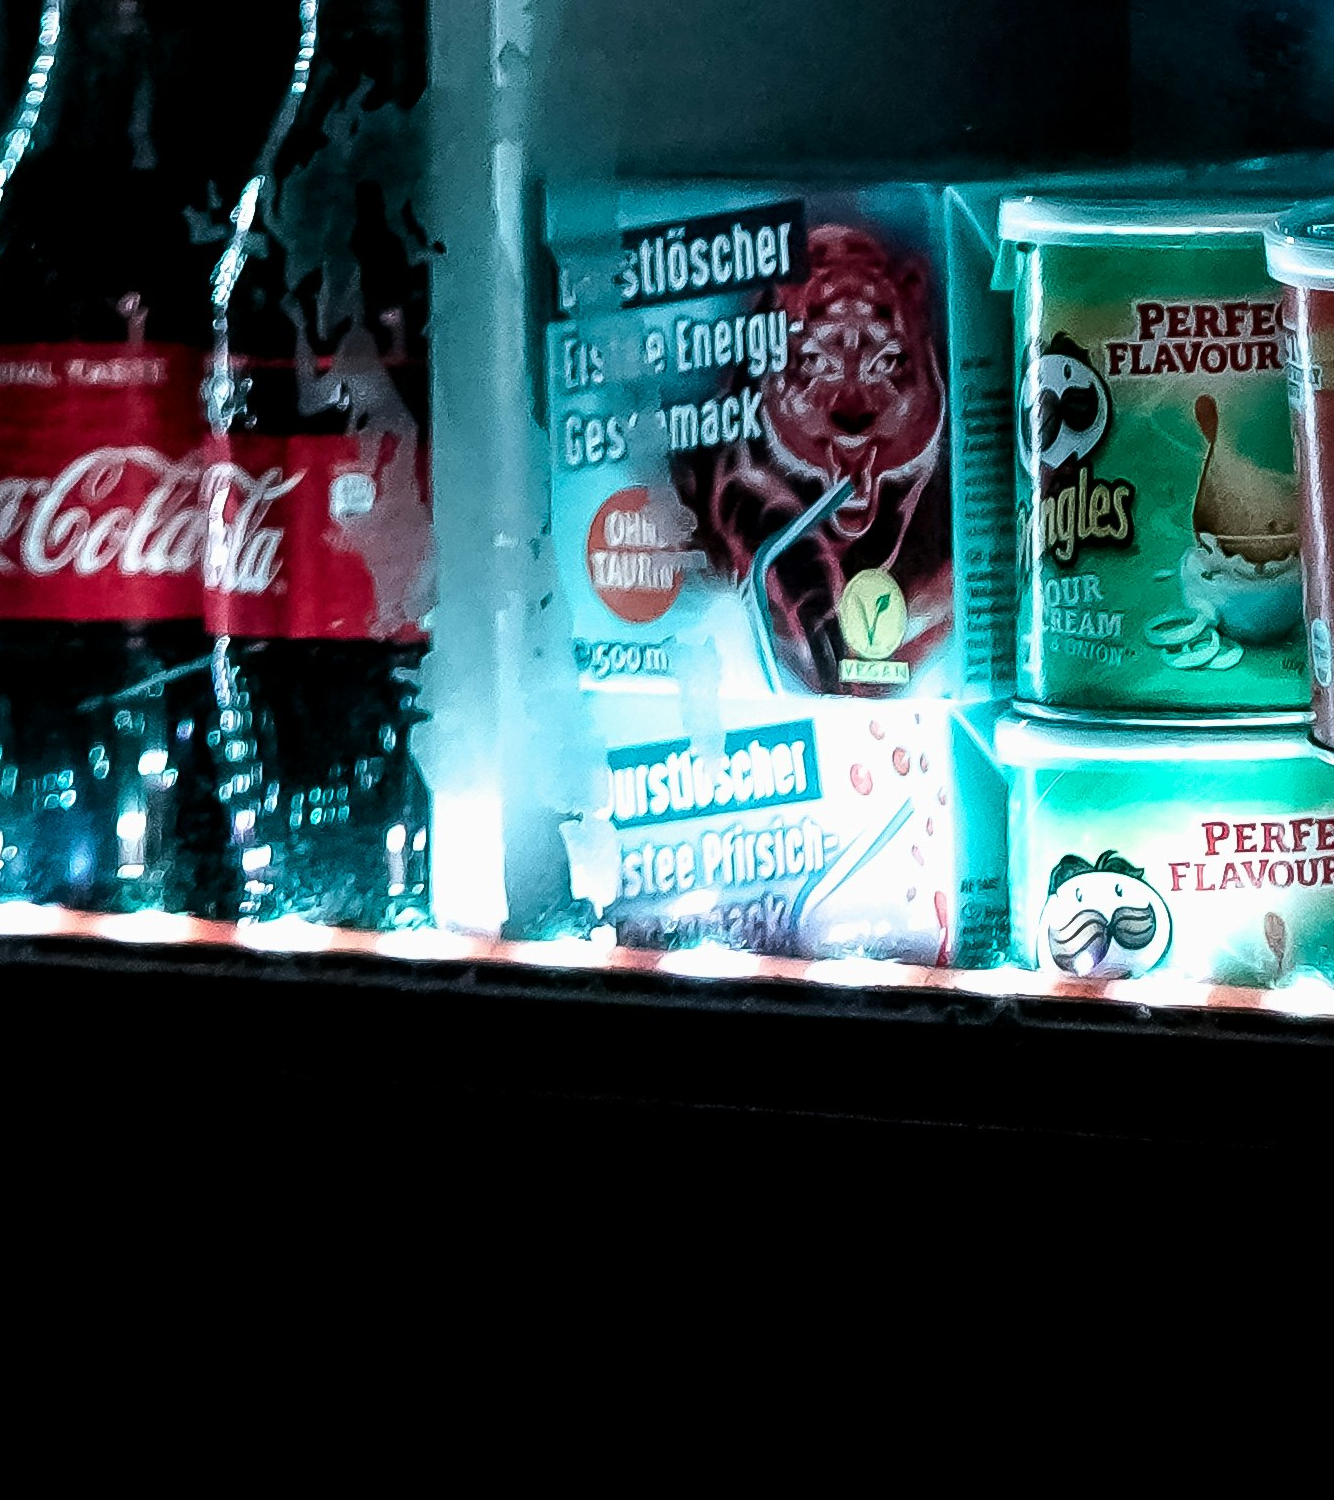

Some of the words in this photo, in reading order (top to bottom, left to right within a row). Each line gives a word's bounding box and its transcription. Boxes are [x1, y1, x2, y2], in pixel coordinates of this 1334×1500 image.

[565, 328, 663, 388] Eise
[676, 311, 805, 378] Energy-
[1107, 341, 1283, 376] FLAVOUR
[565, 392, 764, 466] Gesmack
[1043, 573, 1105, 606] OUR
[841, 661, 906, 683] VEGAN
